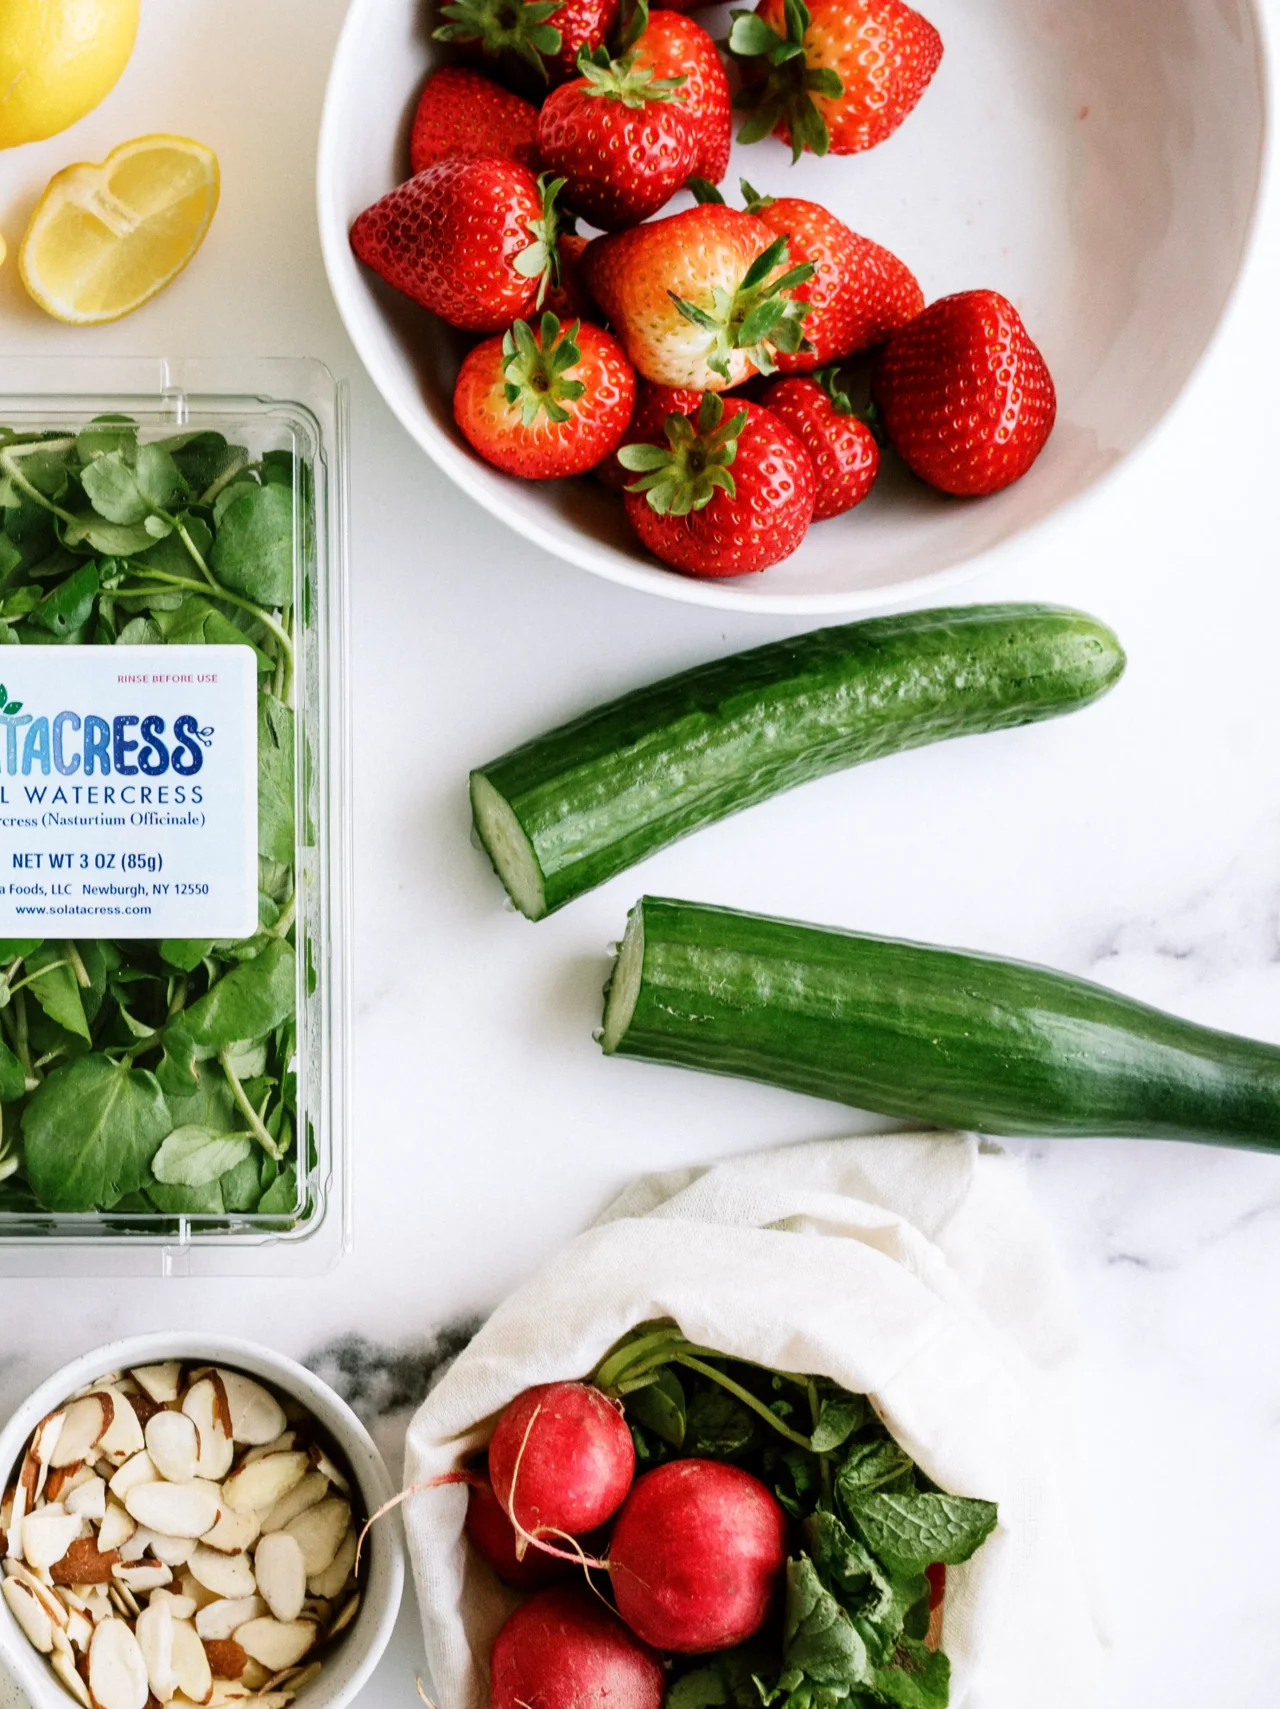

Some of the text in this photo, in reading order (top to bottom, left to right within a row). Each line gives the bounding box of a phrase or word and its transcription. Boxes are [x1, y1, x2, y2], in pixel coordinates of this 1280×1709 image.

[117, 674, 218, 683] RINSE BEFORE USE
[23, 785, 204, 804] WATERCRESS
[41, 811, 126, 829] (Nasturtium
[130, 811, 206, 828] Officinale)
[12, 853, 163, 872] NET WT 3 OZ (85g)
[9, 883, 48, 897] Foods,
[51, 883, 72, 895] LLC
[82, 883, 149, 898] Newburgh,
[152, 883, 170, 895] NY
[174, 883, 209, 895] 12550
[15, 904, 152, 915] www.solatacress.com
